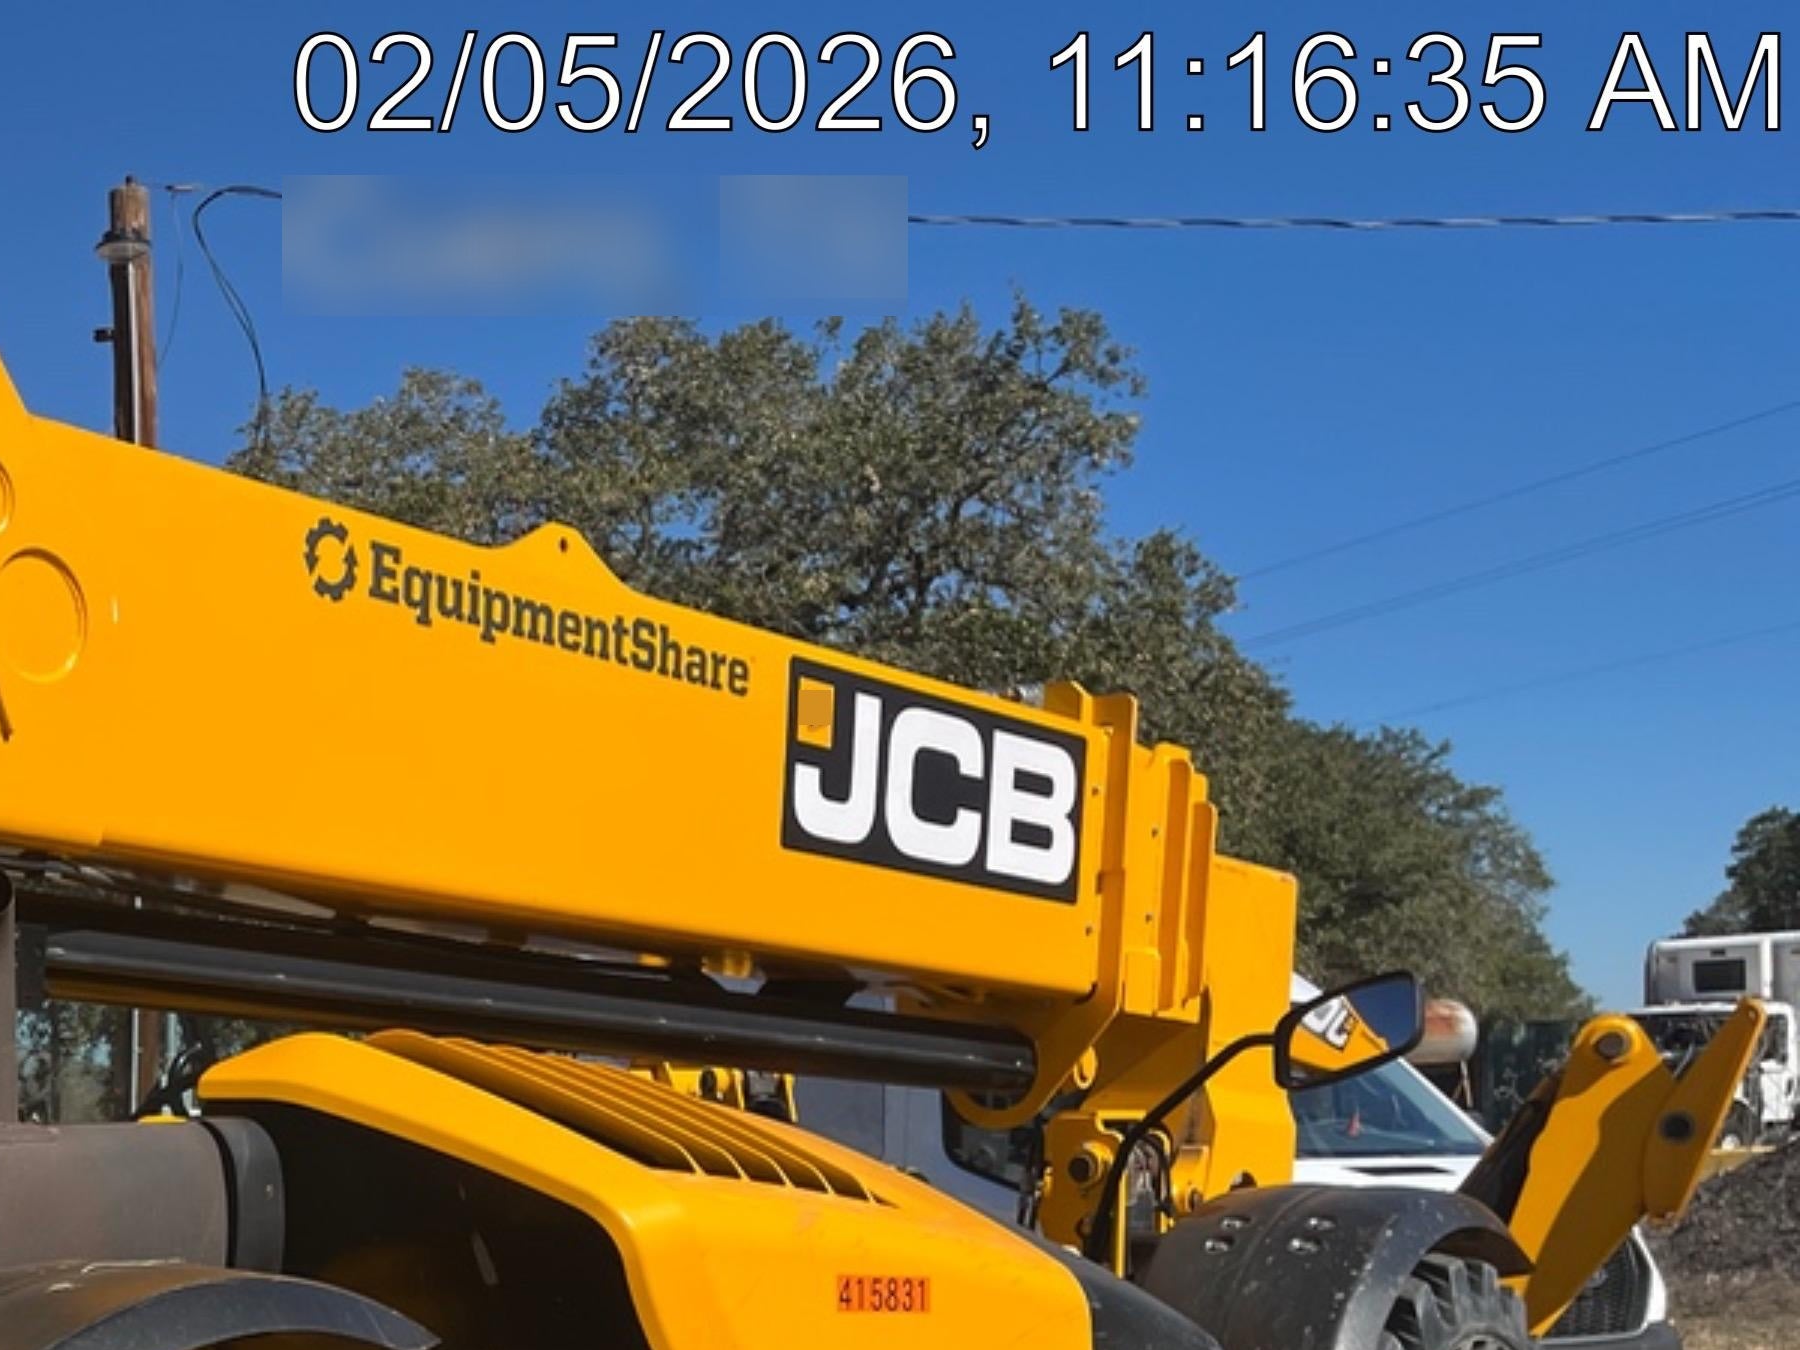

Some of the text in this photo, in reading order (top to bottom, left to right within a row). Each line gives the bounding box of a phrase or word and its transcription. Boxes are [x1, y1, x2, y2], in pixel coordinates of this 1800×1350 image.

[368, 540, 750, 697] EquipmentShare
[794, 691, 1077, 885] JCB
[839, 1277, 926, 1312] 415831
